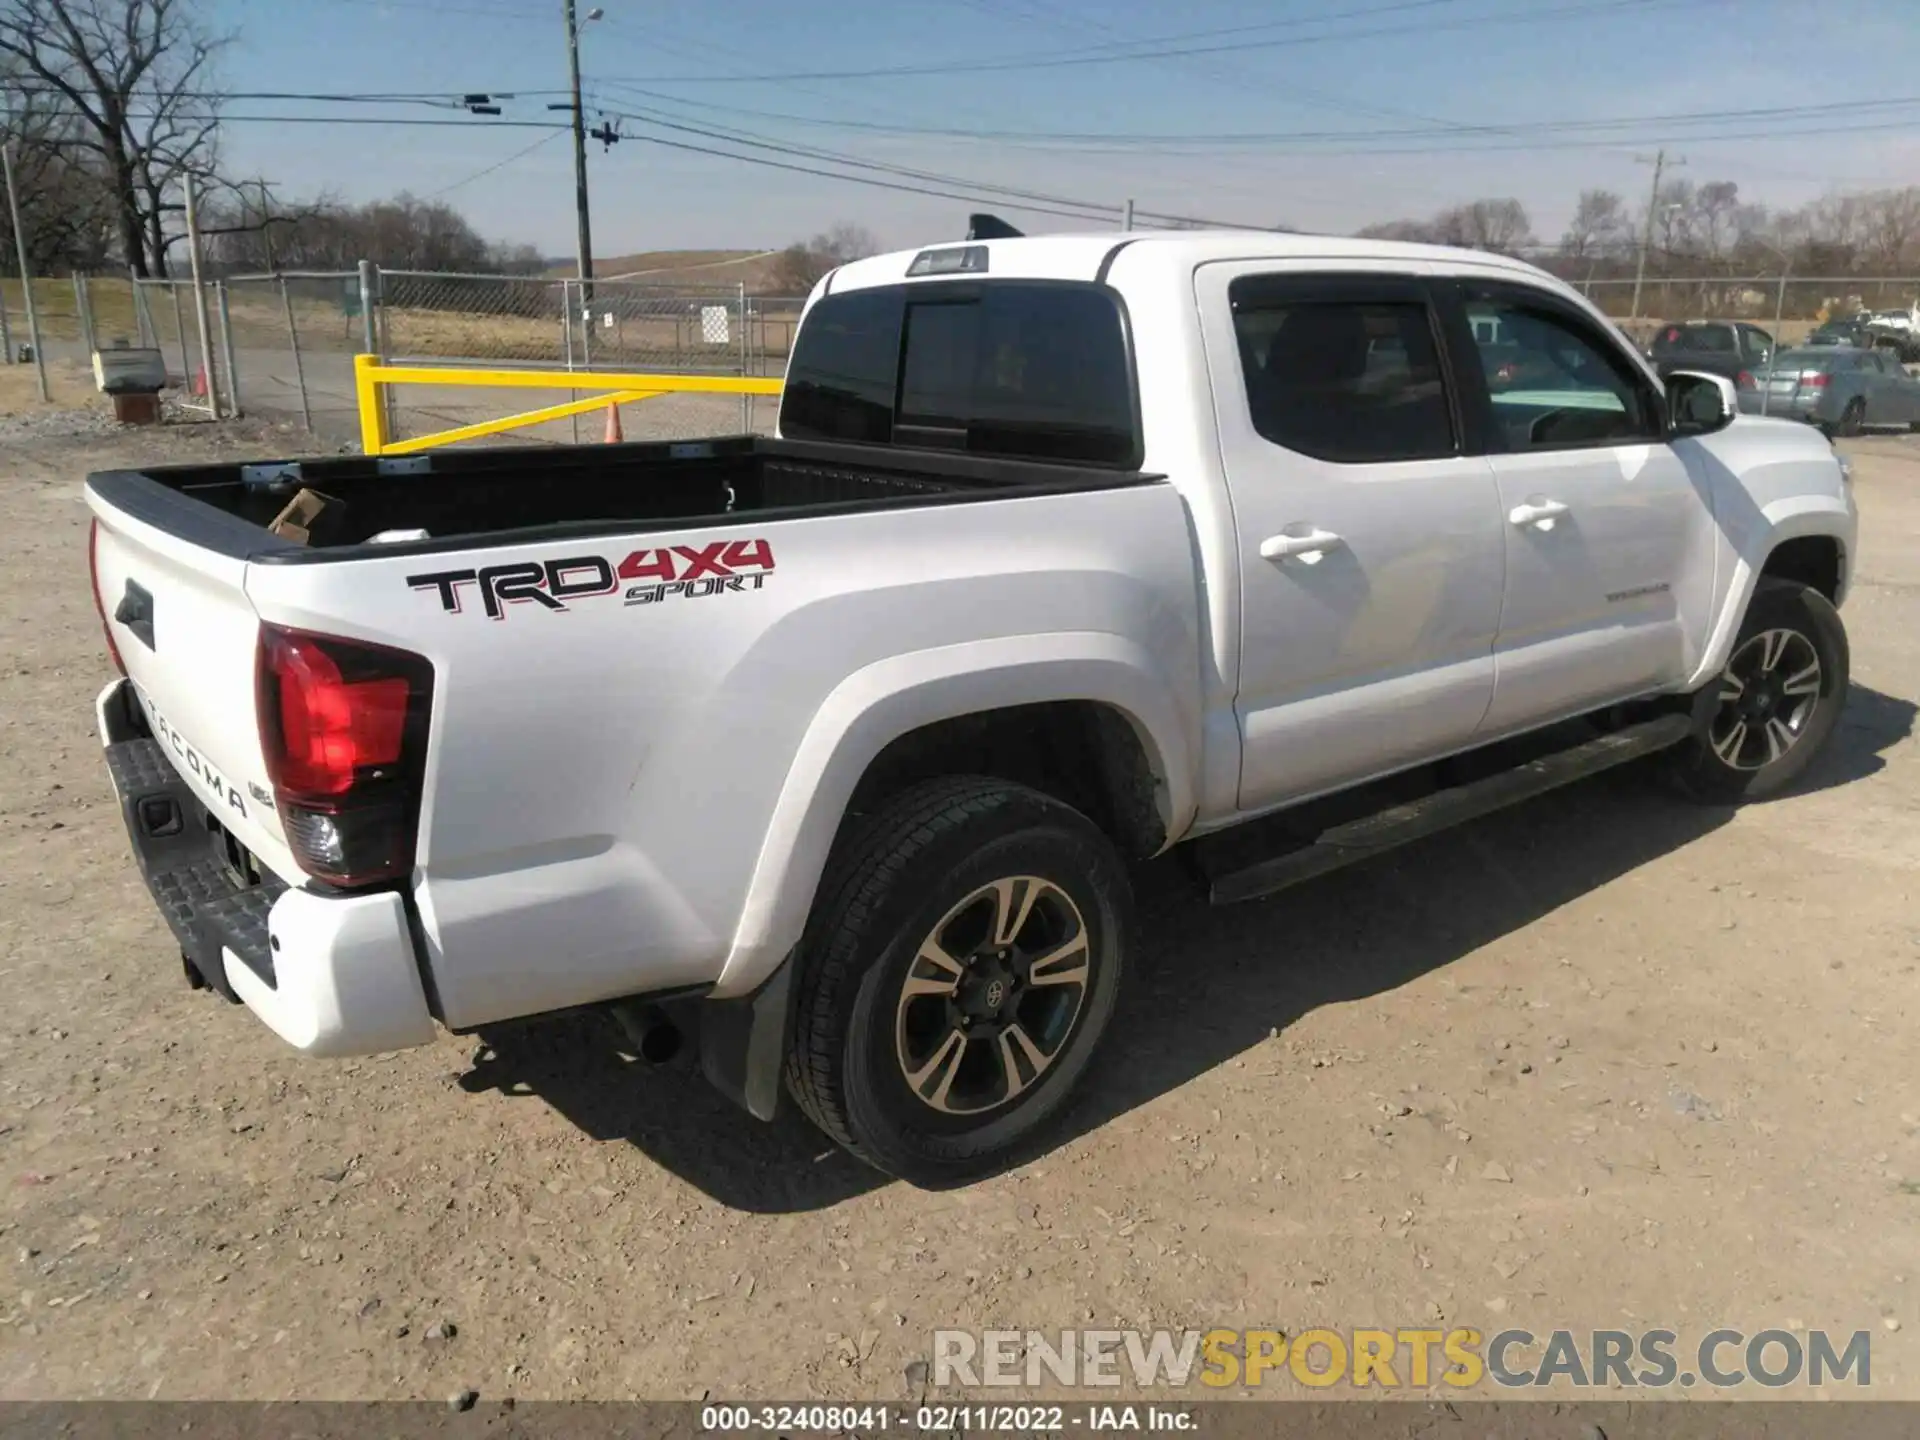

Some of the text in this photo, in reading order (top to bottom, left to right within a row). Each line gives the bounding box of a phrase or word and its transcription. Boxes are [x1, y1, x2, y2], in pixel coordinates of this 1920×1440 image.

[406, 555, 619, 621] TRD
[624, 571, 773, 606] SPORT
[148, 699, 247, 818] TACOMA
